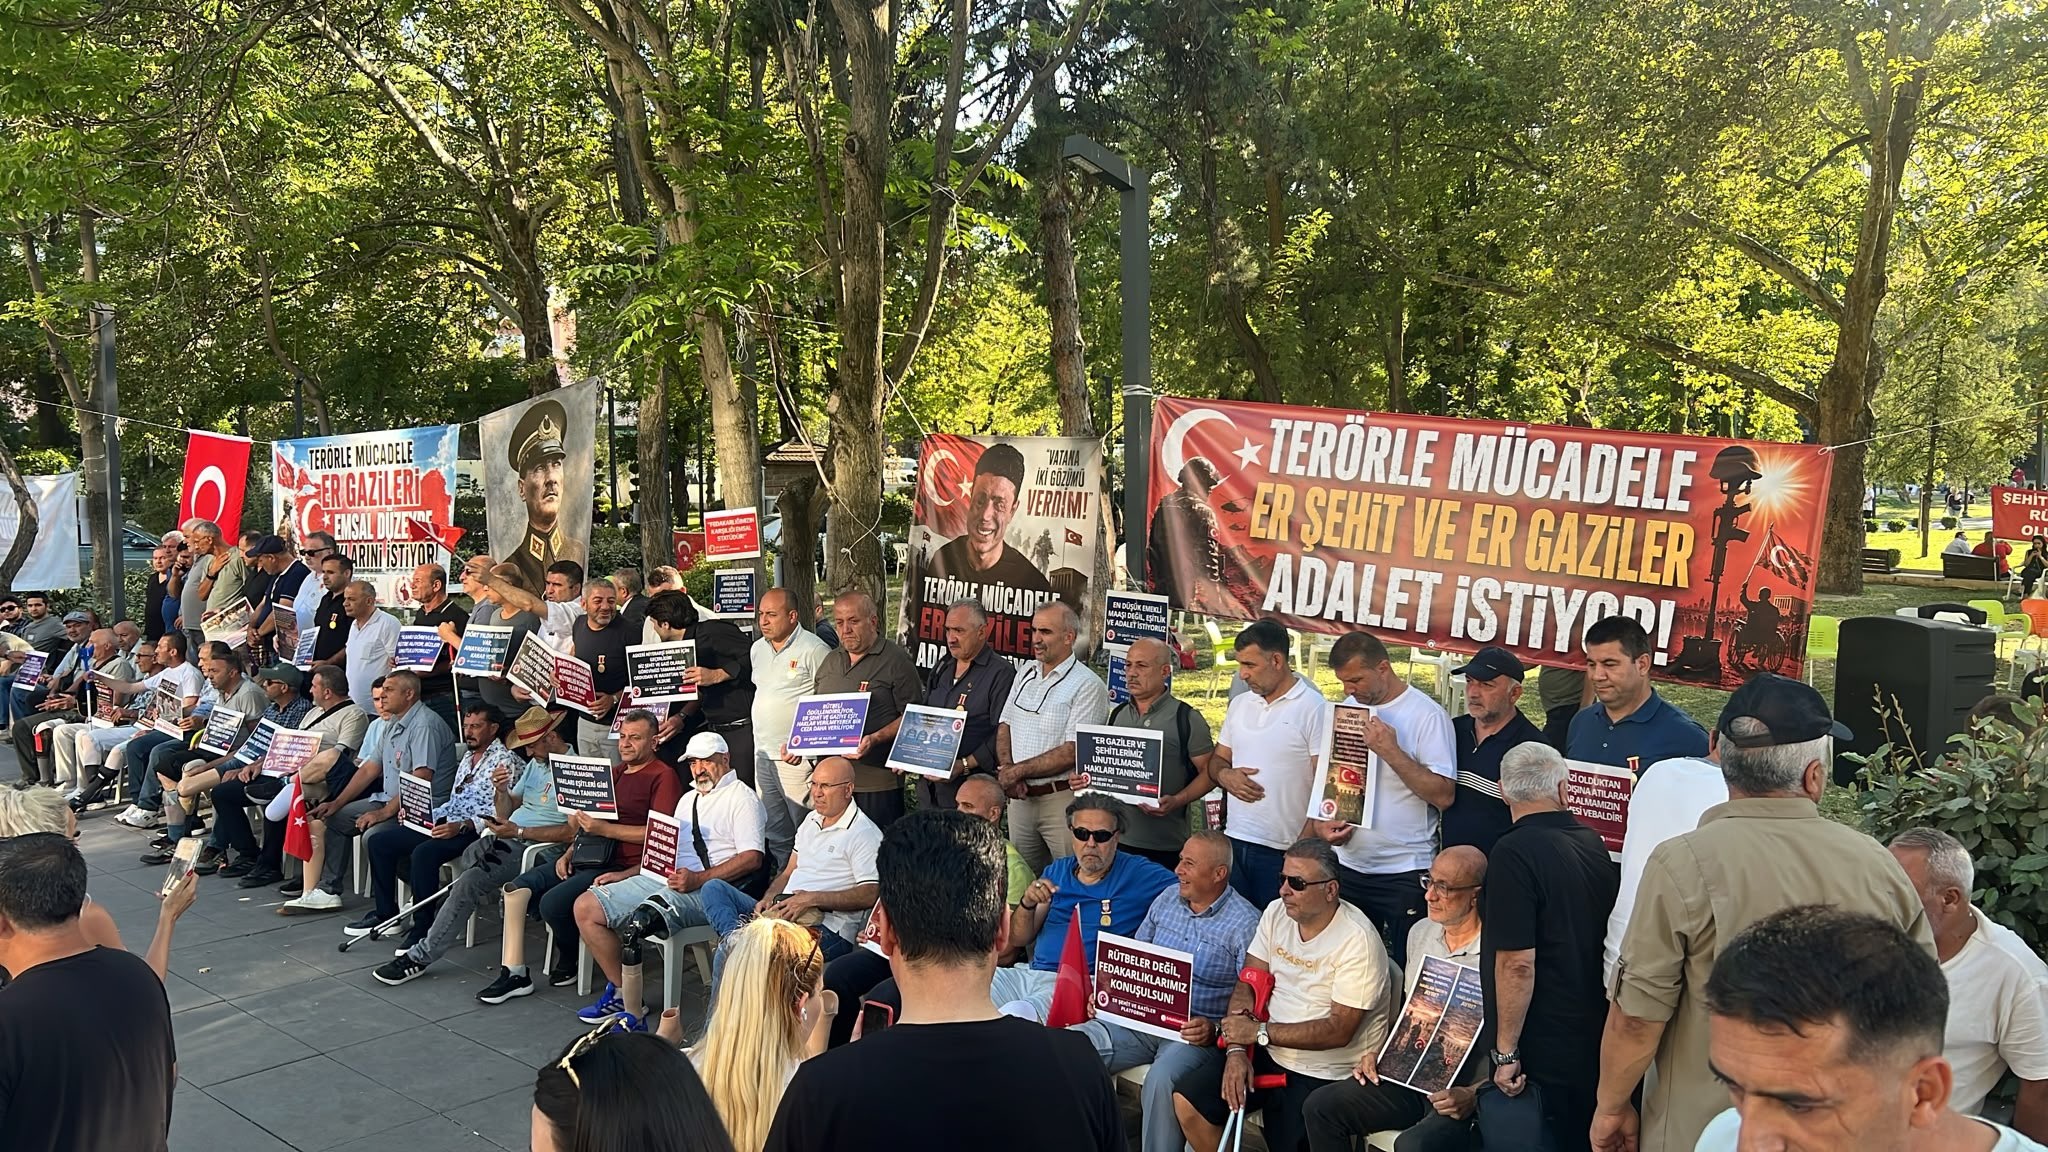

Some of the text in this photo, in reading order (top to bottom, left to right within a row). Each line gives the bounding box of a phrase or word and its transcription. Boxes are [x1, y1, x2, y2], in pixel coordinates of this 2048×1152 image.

[309, 441, 413, 470] TERÖRLE MÜCADELE
[1269, 414, 1697, 512] TERÖRLE MÜCADELE
[1035, 467, 1085, 487] İKİ GÖZÜMÜ
[321, 474, 341, 508] ER
[335, 513, 374, 541] EMSAL
[1250, 481, 1695, 589] ER ŞEHİT VE ER GAZİLER
[1261, 552, 1443, 634] ADALET
[1113, 601, 1162, 613] EN DÜŞÜK EMEKLİ
[919, 607, 946, 641] ER
[1108, 611, 1126, 619] MAAŞI
[1146, 614, 1166, 624] EŞİTLİK
[1114, 619, 1136, 628] ADALET
[1137, 621, 1166, 632] İSTİYORUZ
[1106, 737, 1136, 748] GAZİLER
[1136, 741, 1146, 749] VE
[1095, 746, 1143, 759] ŞEHİTLERİMİZ
[1084, 764, 1114, 775] HAKLARI
[1092, 756, 1145, 770] UNUTULMASIN,
[1578, 775, 1620, 789] OLDUKTAN
[1591, 788, 1630, 801] ATILARAK
[1576, 796, 1620, 811] ALMAMIZIN
[1583, 808, 1623, 823] VEBALDİR!
[1108, 949, 1181, 978] RÜTBELER DEĞİL,
[1098, 961, 1187, 993] FEDAKARLIKLARIMIZ
[1110, 978, 1174, 1004] KONUŞULSUN!
